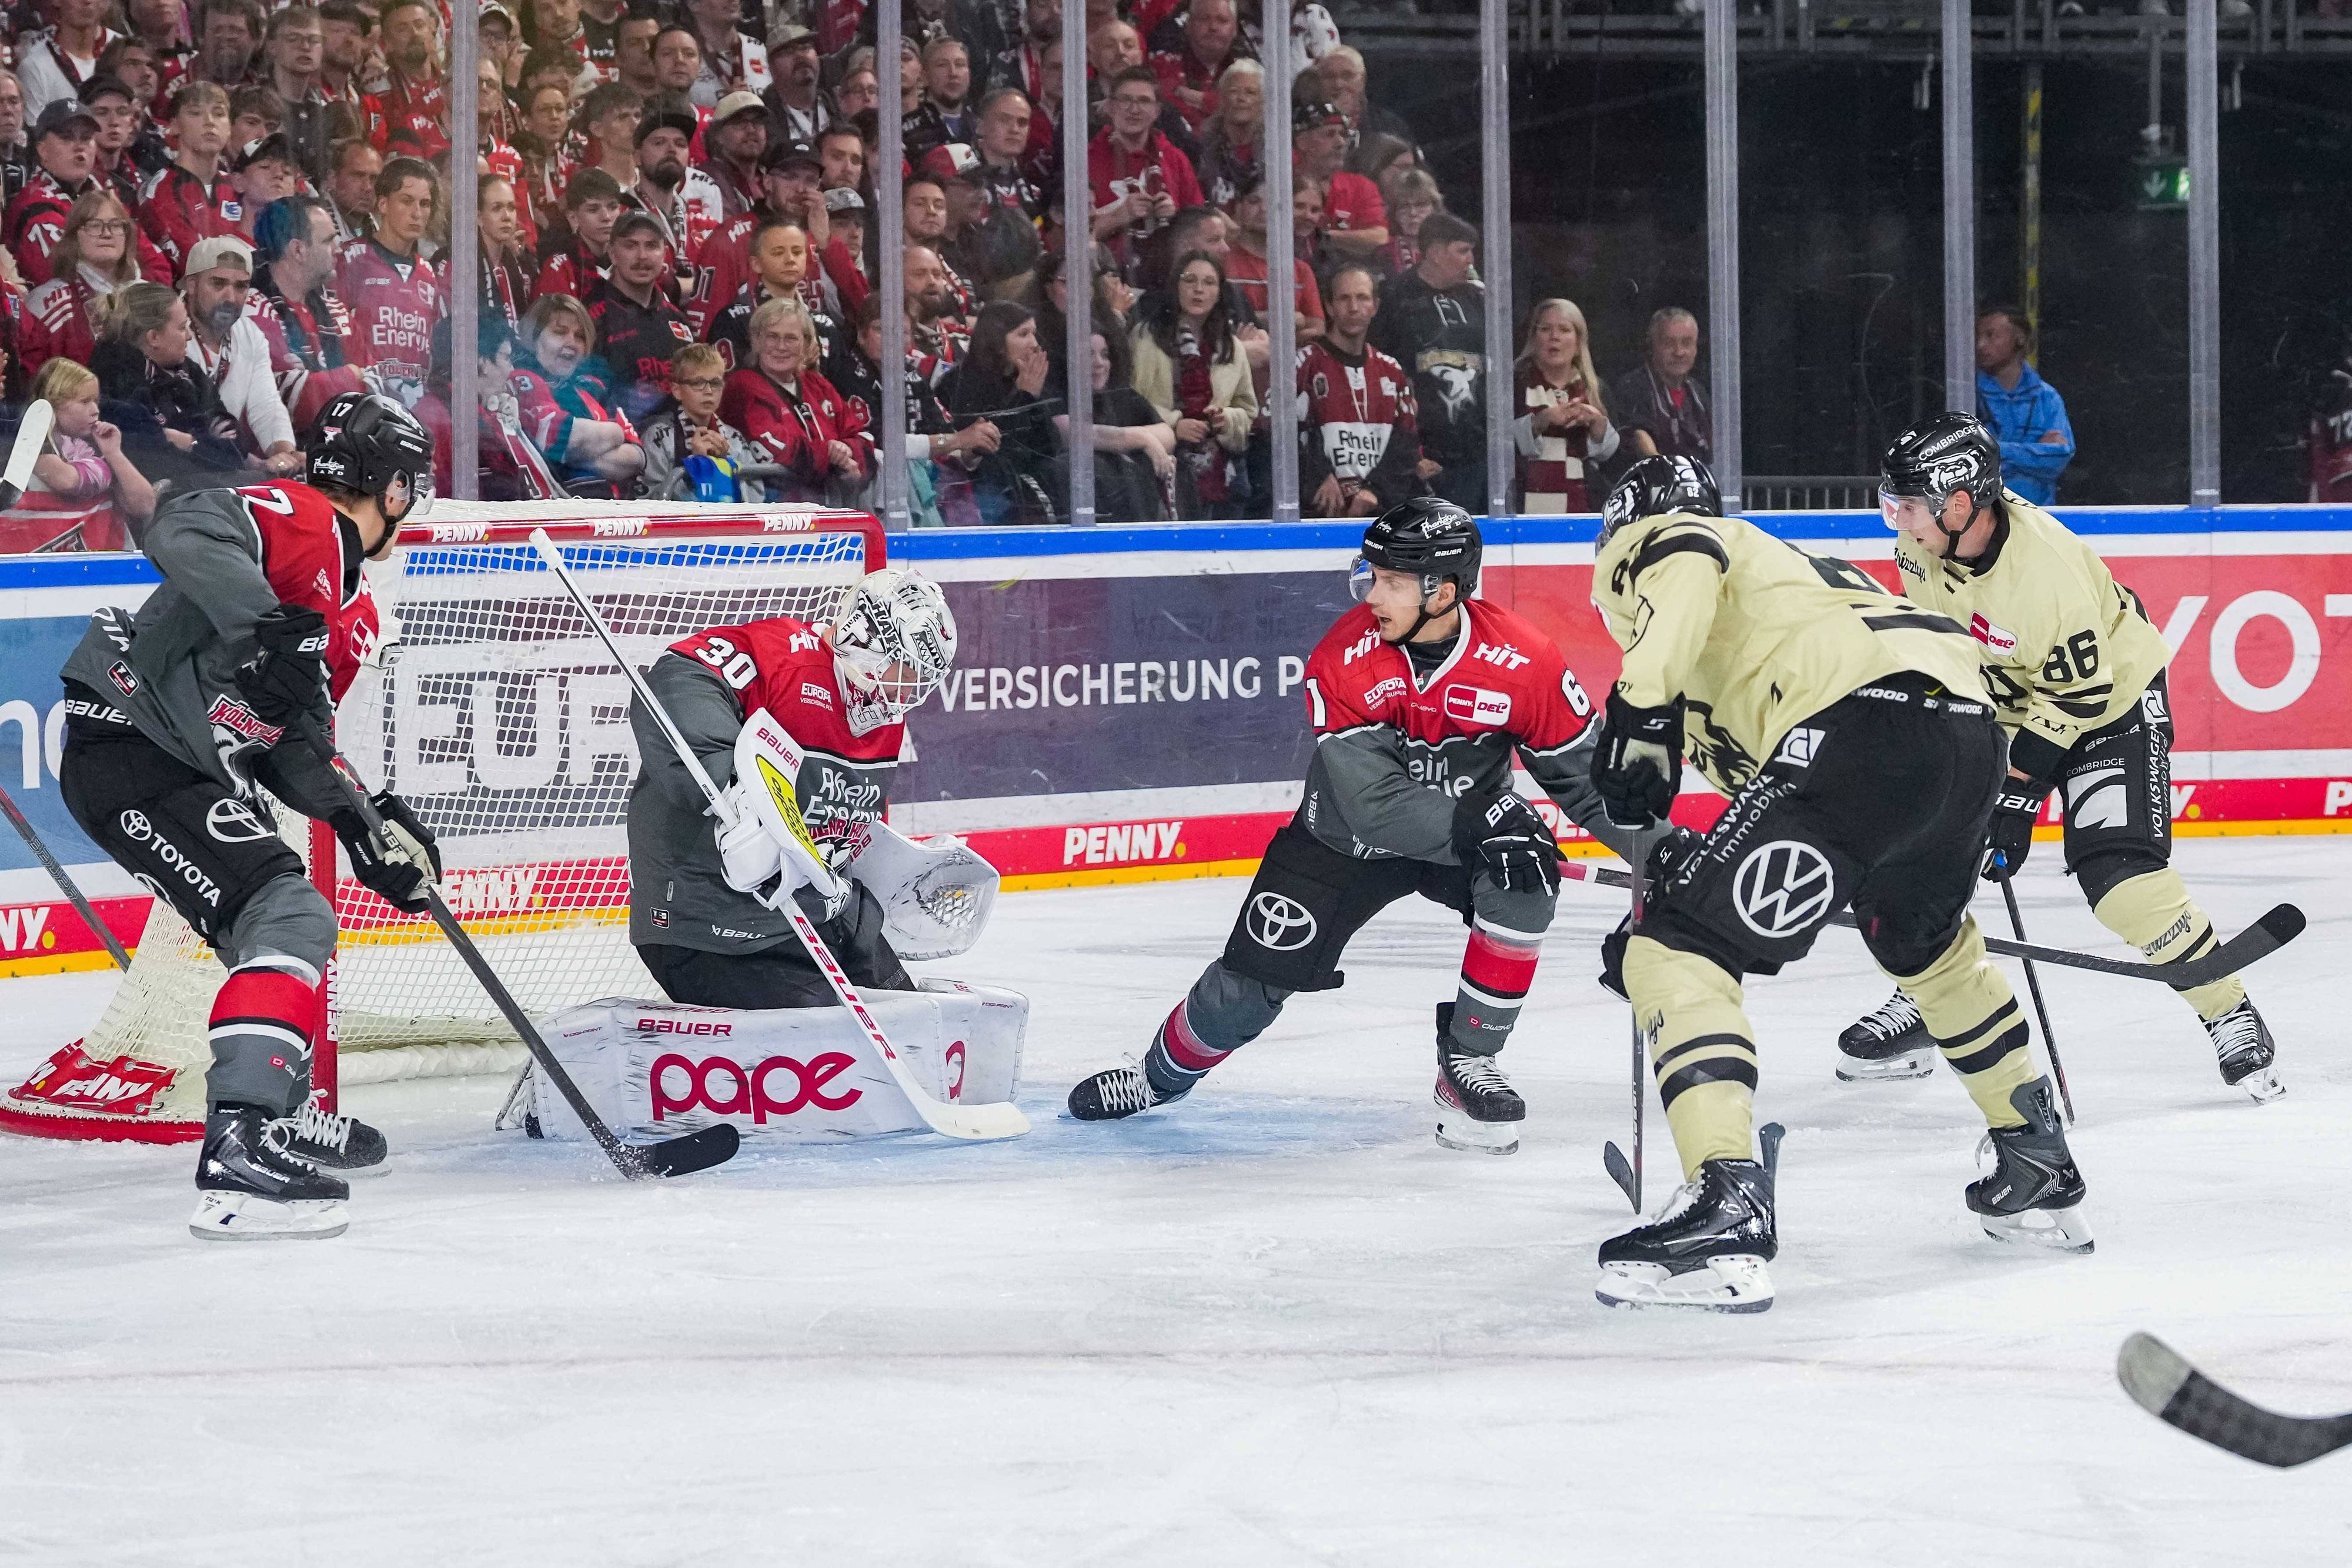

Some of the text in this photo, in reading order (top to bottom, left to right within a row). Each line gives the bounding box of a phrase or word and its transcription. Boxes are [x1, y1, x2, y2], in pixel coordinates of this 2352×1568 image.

[379, 306, 427, 332] Rhein
[330, 402, 353, 417] 17
[1918, 424, 1978, 461] COMBRIDGE
[1686, 487, 1699, 498] 82
[1420, 511, 1458, 533] Phantasia
[1425, 521, 1462, 540] LAND
[789, 627, 820, 654] HIT
[1344, 627, 1381, 667] HIT
[694, 636, 759, 691] 30
[1472, 641, 1531, 671] HIT
[2042, 628, 2100, 684] 86
[800, 683, 833, 705] EUROPA
[940, 656, 1262, 713] VERSICHERUNG
[65, 698, 133, 726] BAUE
[1476, 701, 1509, 714] DEL
[2066, 757, 2126, 778] COMBRIDGE
[2149, 722, 2163, 838] VOLKSWAGEN
[818, 767, 881, 808] Rhein
[151, 833, 221, 908] TOYOTA
[794, 915, 897, 1061] BAUER
[637, 1018, 732, 1037] BAUER
[649, 1052, 864, 1125] pape
[1991, 1184, 2013, 1205] BAUER
